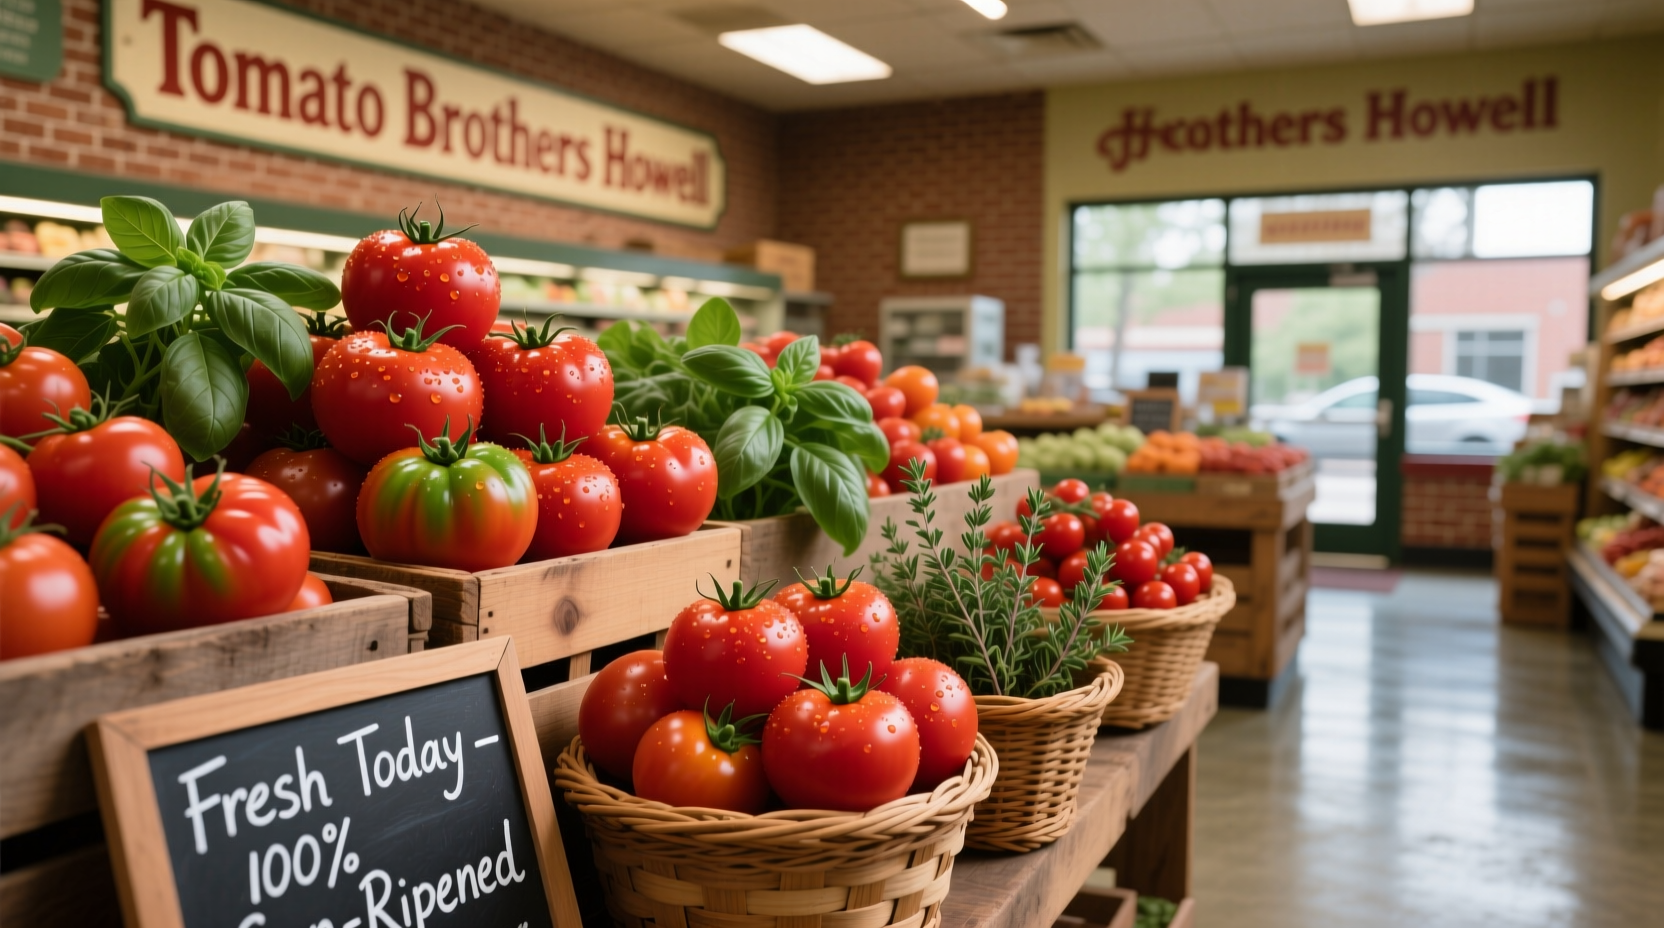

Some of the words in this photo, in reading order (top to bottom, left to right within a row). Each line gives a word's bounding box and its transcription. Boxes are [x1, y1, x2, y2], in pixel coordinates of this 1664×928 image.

[142, 0, 384, 137] Tomato
[403, 67, 592, 182] Brothers
[603, 123, 711, 206] Howell
[1364, 75, 1560, 143] Howell
[178, 746, 333, 854] Fresh
[336, 715, 464, 800] Today
[249, 816, 360, 905] 100%
